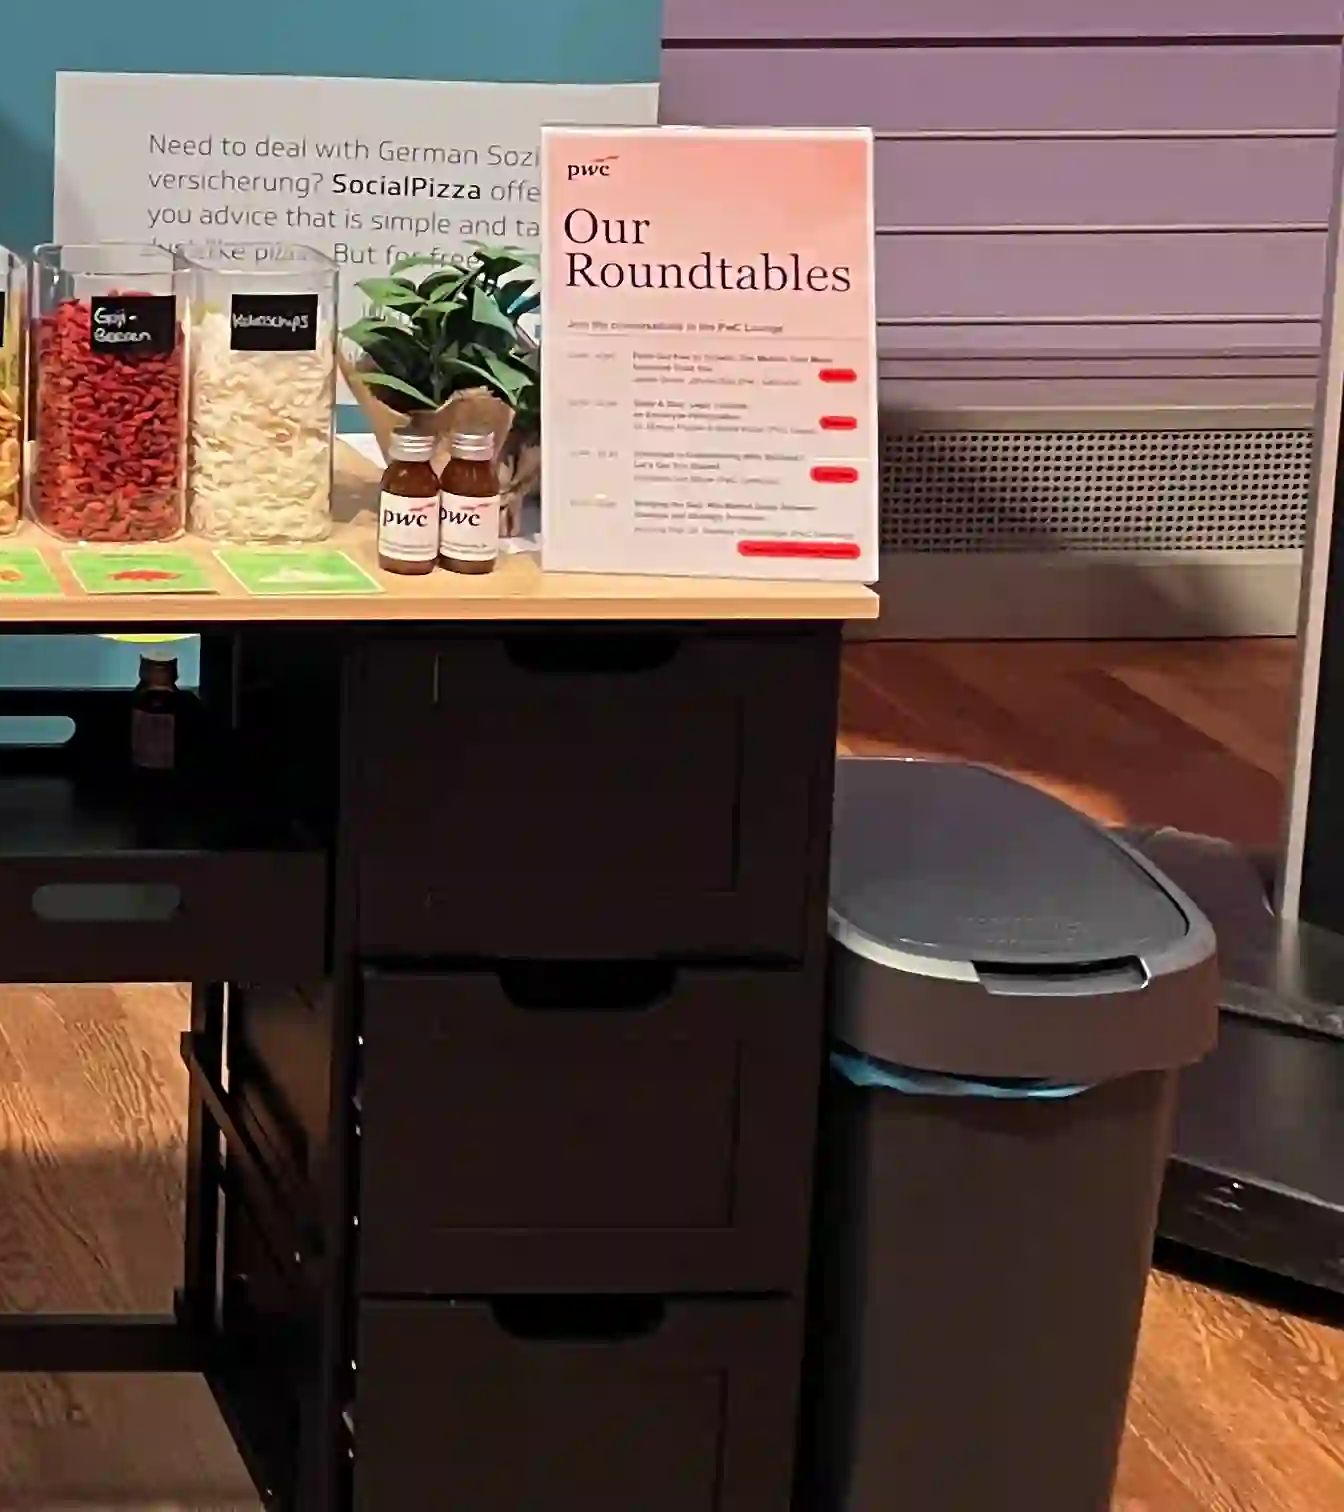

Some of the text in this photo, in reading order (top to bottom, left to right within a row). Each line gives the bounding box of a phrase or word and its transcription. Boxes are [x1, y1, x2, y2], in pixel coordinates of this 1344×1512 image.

[149, 133, 213, 157] Need
[220, 137, 248, 158] to
[255, 135, 307, 159] deal
[315, 139, 369, 161] with
[378, 140, 479, 166] German
[148, 170, 323, 199] versicherung?
[331, 173, 482, 200] SocialPizza
[567, 162, 611, 181] pwc
[148, 208, 192, 230] you
[199, 205, 278, 228] advice
[287, 206, 336, 229] that
[345, 209, 362, 230] is
[371, 211, 451, 237] simple
[459, 215, 506, 237] and
[564, 207, 651, 246] Our
[334, 242, 378, 265] But
[565, 251, 852, 292] Roundtables
[382, 509, 429, 527] pwc
